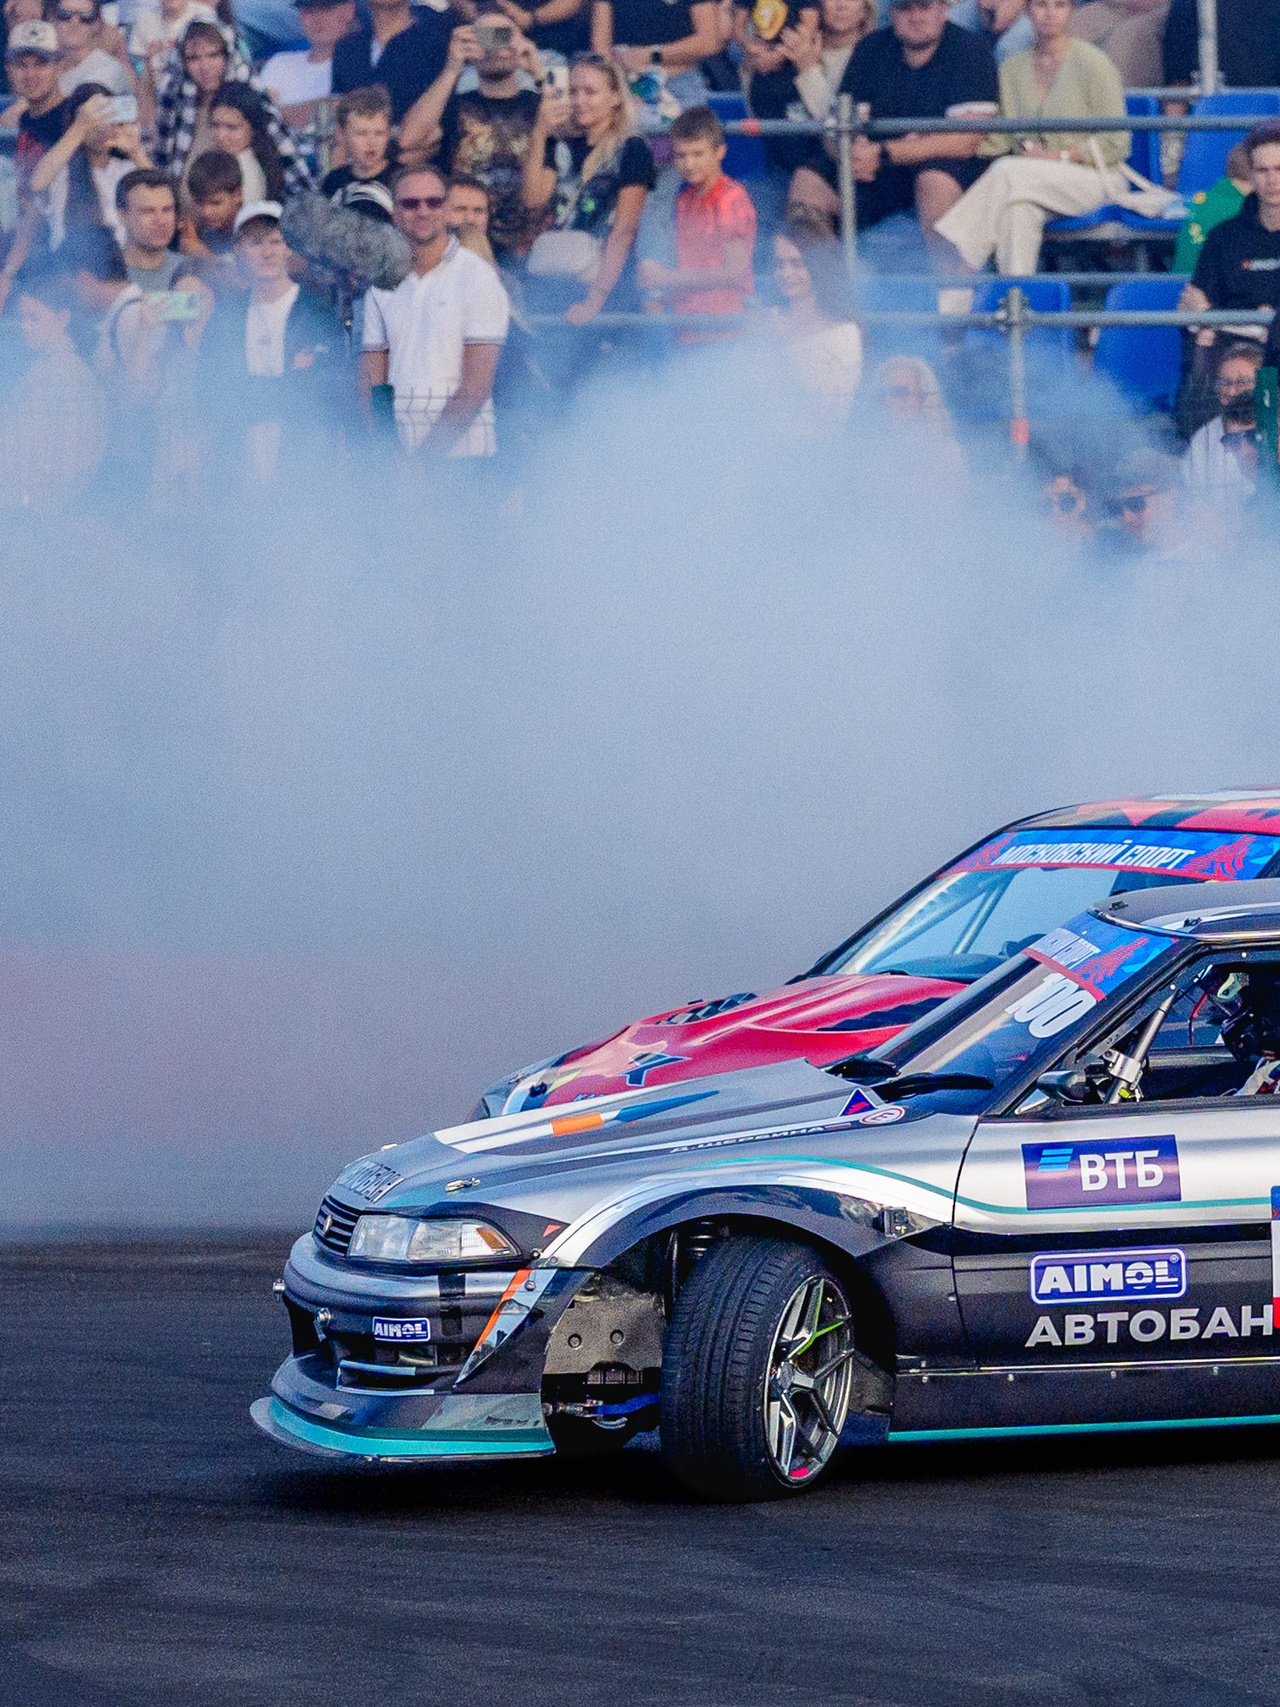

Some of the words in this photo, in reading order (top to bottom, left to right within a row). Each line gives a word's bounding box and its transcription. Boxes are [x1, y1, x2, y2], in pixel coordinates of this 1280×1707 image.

[1113, 844, 1196, 870] СПОРТ
[1004, 972, 1097, 1038] 100
[1079, 1149, 1164, 1192] ВТБ
[1036, 1259, 1180, 1294] AIMOL
[374, 1322, 427, 1338] AIMOL
[1025, 1305, 1273, 1348] АВТОБАН
